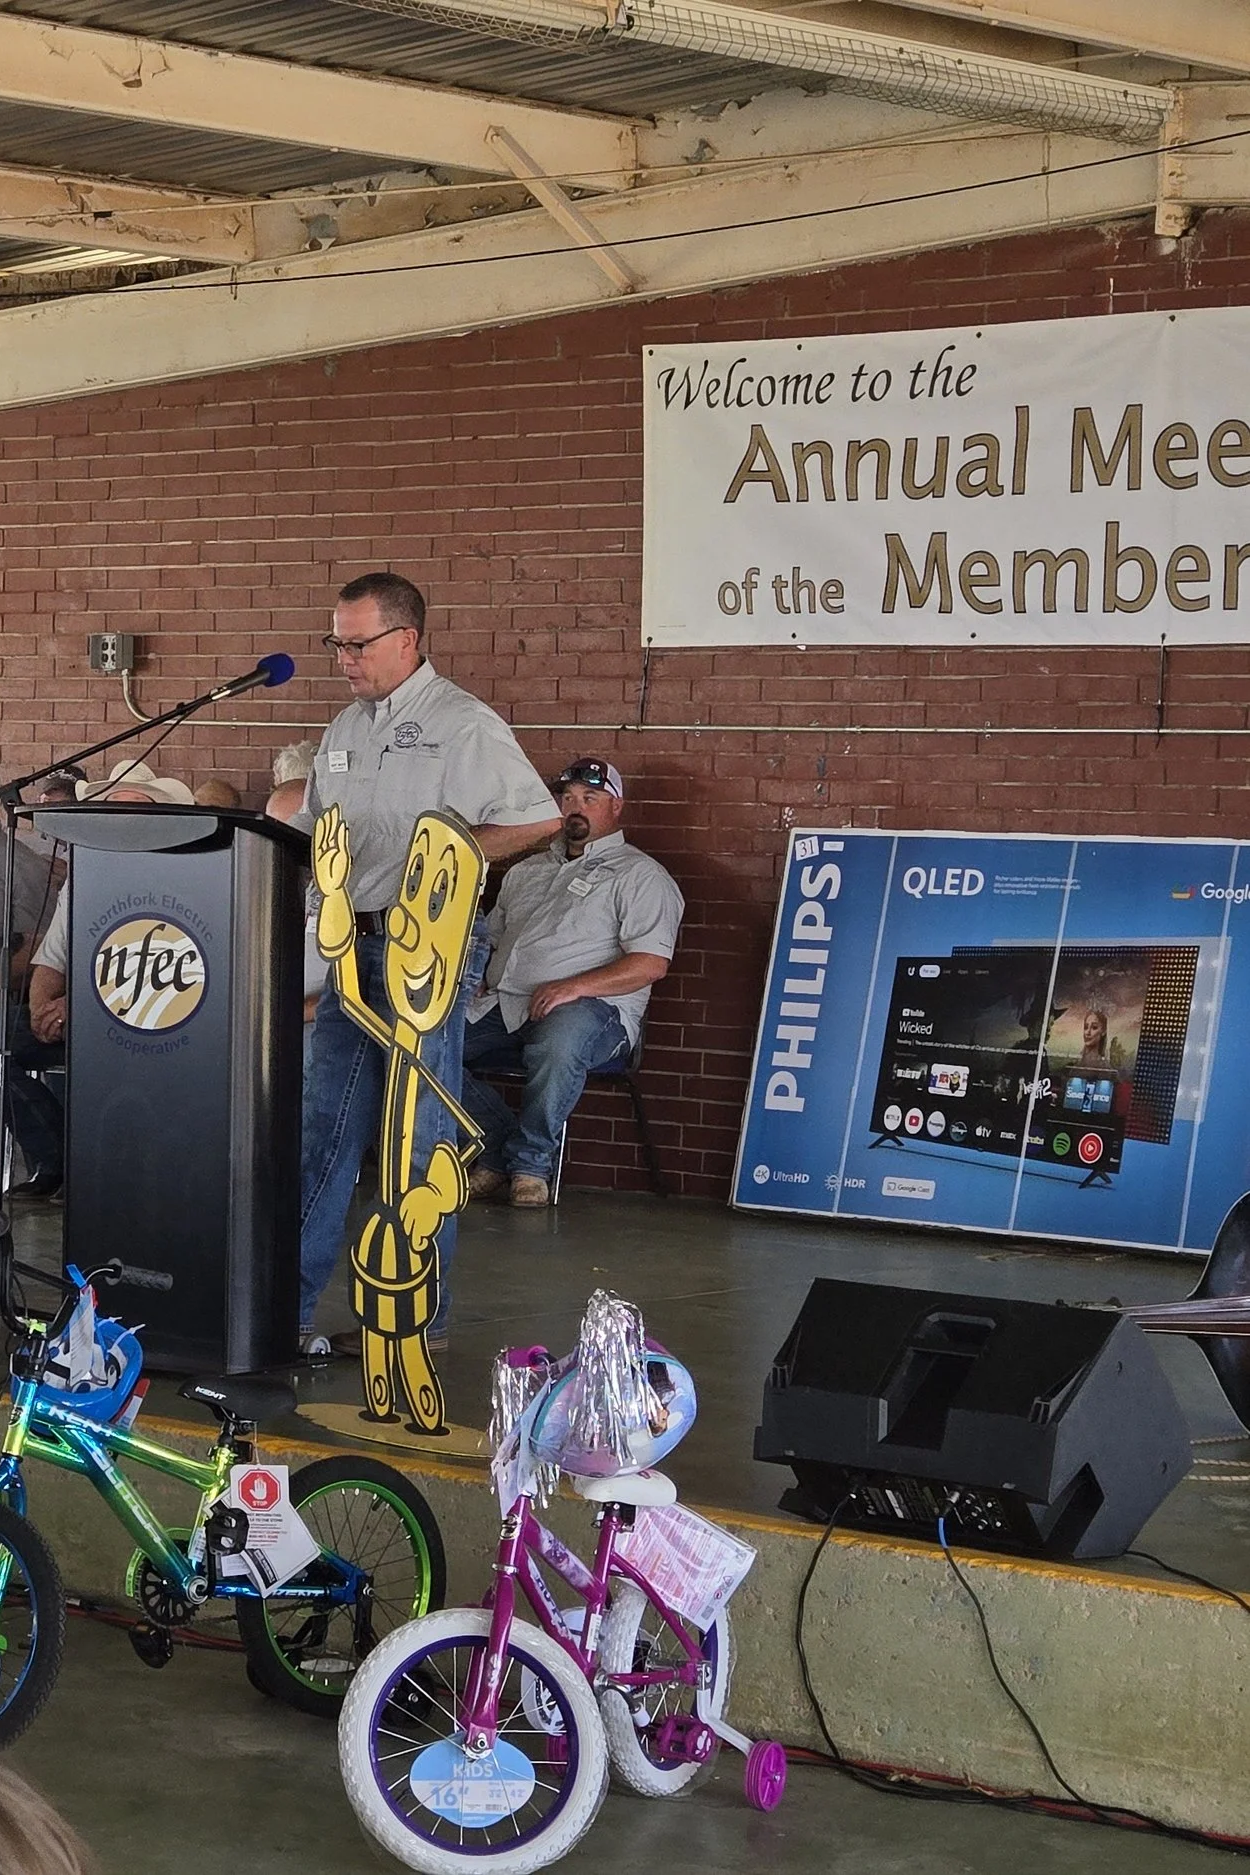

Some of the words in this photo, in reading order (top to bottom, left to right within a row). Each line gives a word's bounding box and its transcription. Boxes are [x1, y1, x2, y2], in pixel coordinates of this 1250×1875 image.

[657, 358, 834, 411] Welcome
[851, 362, 892, 402] to
[908, 345, 978, 398] the
[723, 405, 1030, 504] Annual
[1069, 403, 1250, 493] Mee
[718, 567, 760, 615] of
[773, 566, 845, 615] the
[799, 840, 817, 858] 31
[902, 866, 985, 899] QLED
[1201, 881, 1250, 904] Googl
[87, 892, 158, 940] Northfork
[161, 894, 214, 943] Electric
[98, 923, 198, 1016] nfec
[764, 863, 842, 1113] PHILIPS
[106, 1026, 191, 1057] Cooperative
[899, 1020, 933, 1036] Wicked
[755, 1169, 768, 1178] 4K
[773, 1171, 810, 1184] UltraHD
[844, 1178, 866, 1189] HDR
[453, 1763, 494, 1778] KIDS
